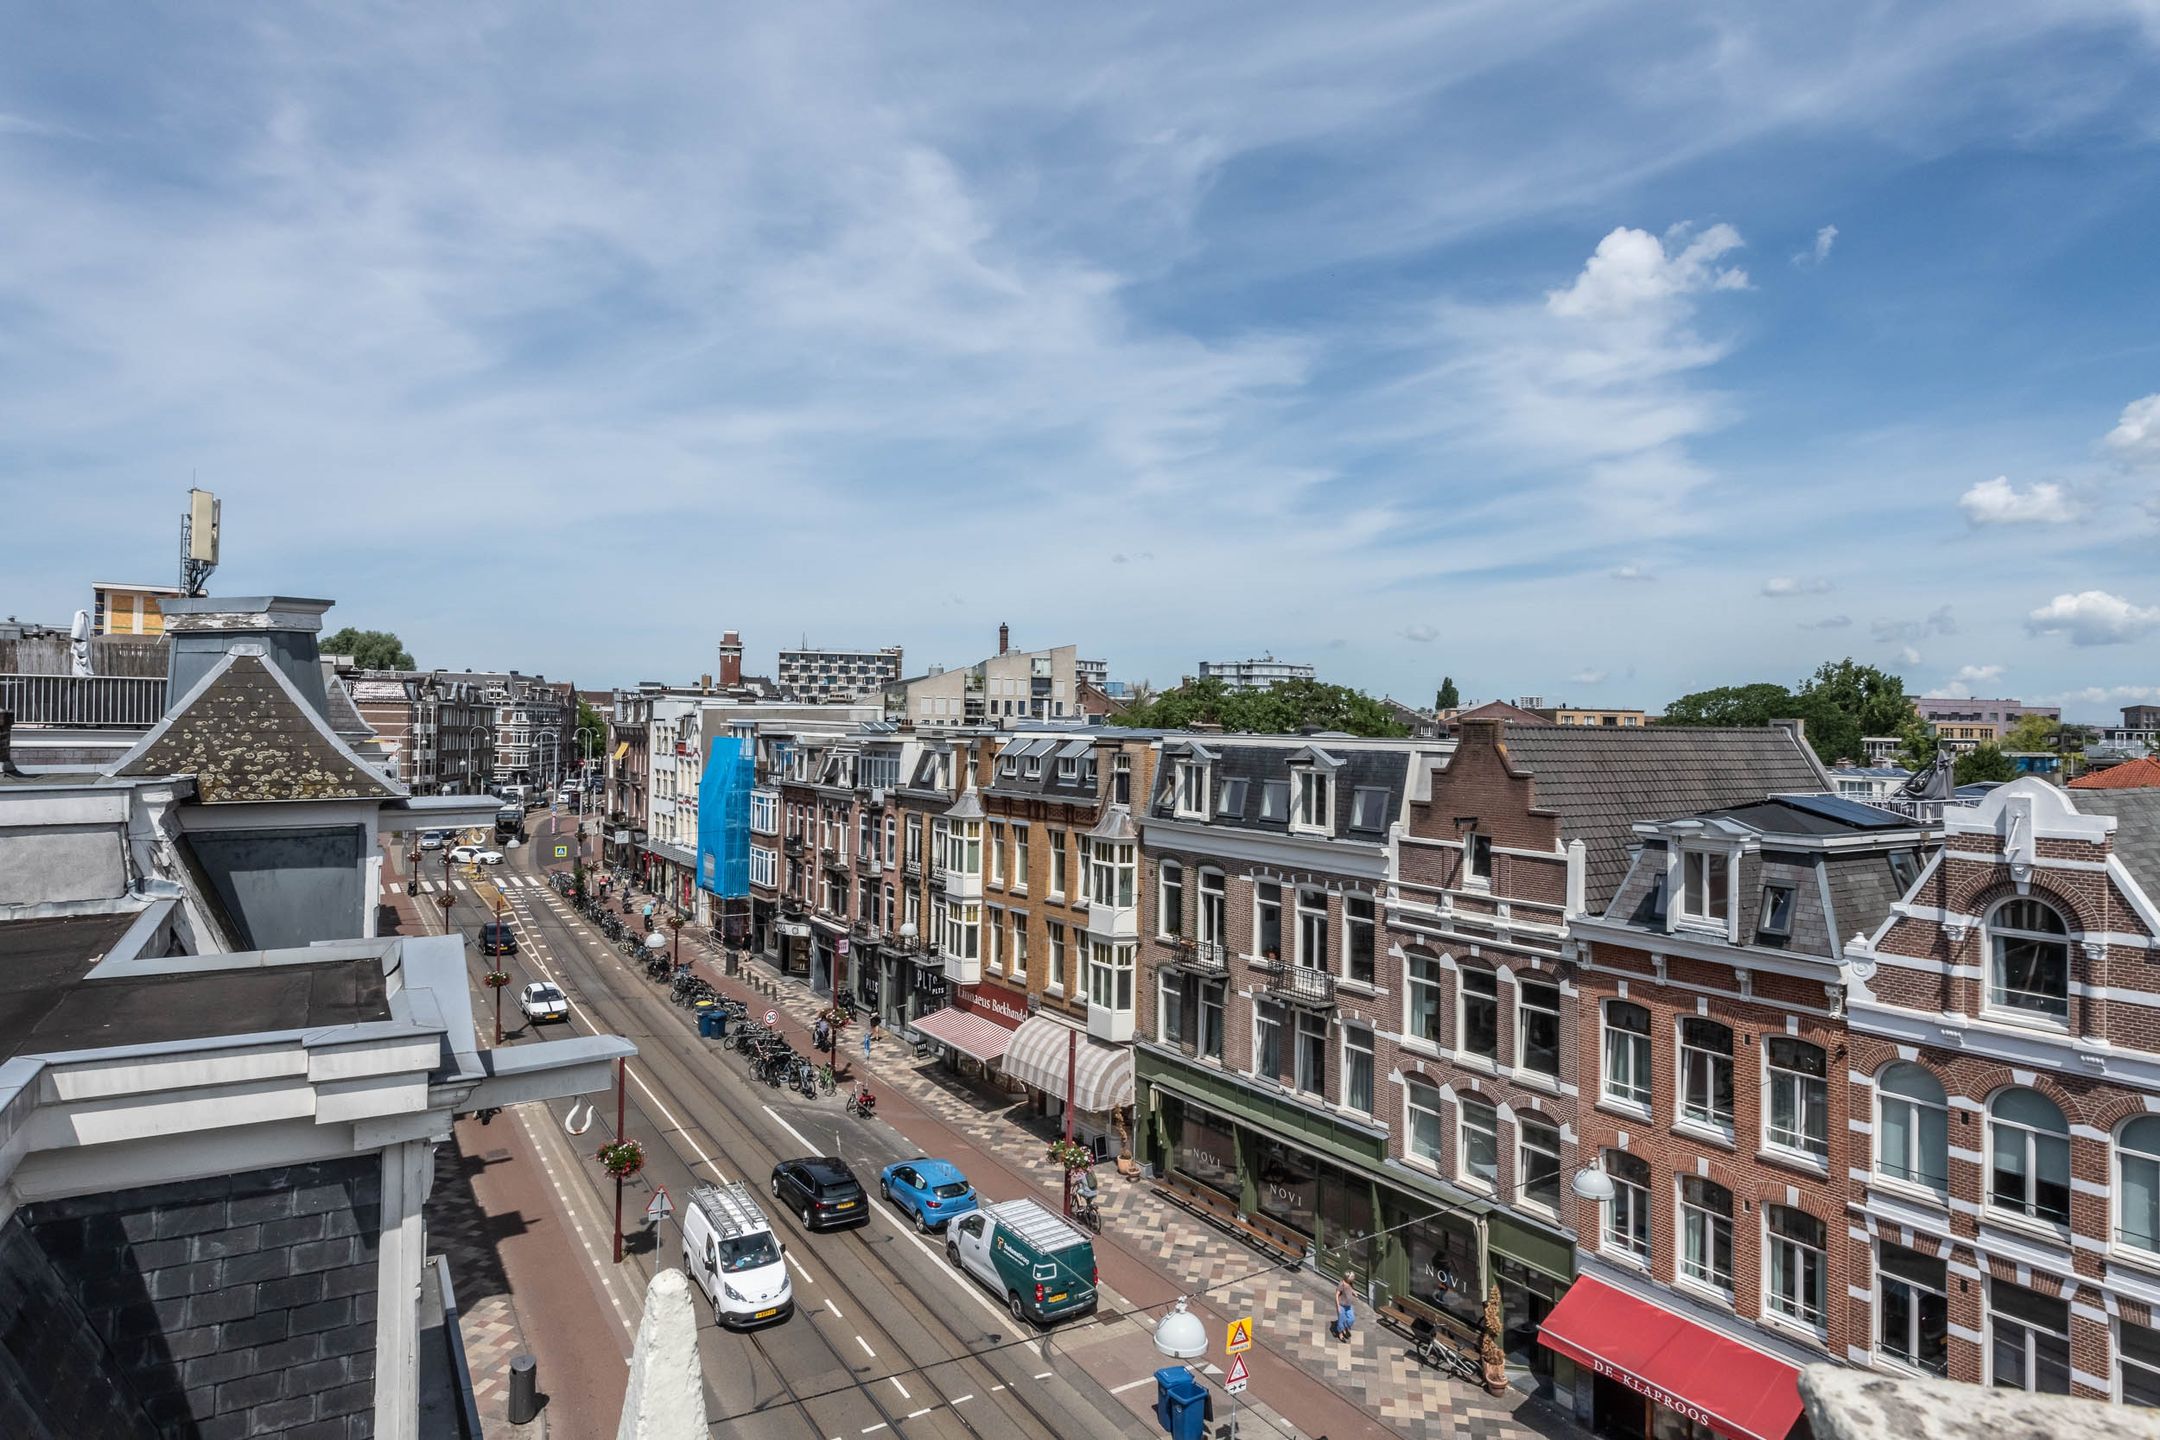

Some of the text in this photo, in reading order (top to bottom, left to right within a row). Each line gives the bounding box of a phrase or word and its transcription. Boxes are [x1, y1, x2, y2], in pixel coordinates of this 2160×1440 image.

[931, 987, 945, 995] PLTS
[767, 1013, 776, 1022] 30
[1193, 1147, 1221, 1168] NOVI
[1269, 1183, 1302, 1207] NOVI
[1425, 1263, 1468, 1293] NOVI
[1593, 1359, 1709, 1427] DE KLAPROOS
